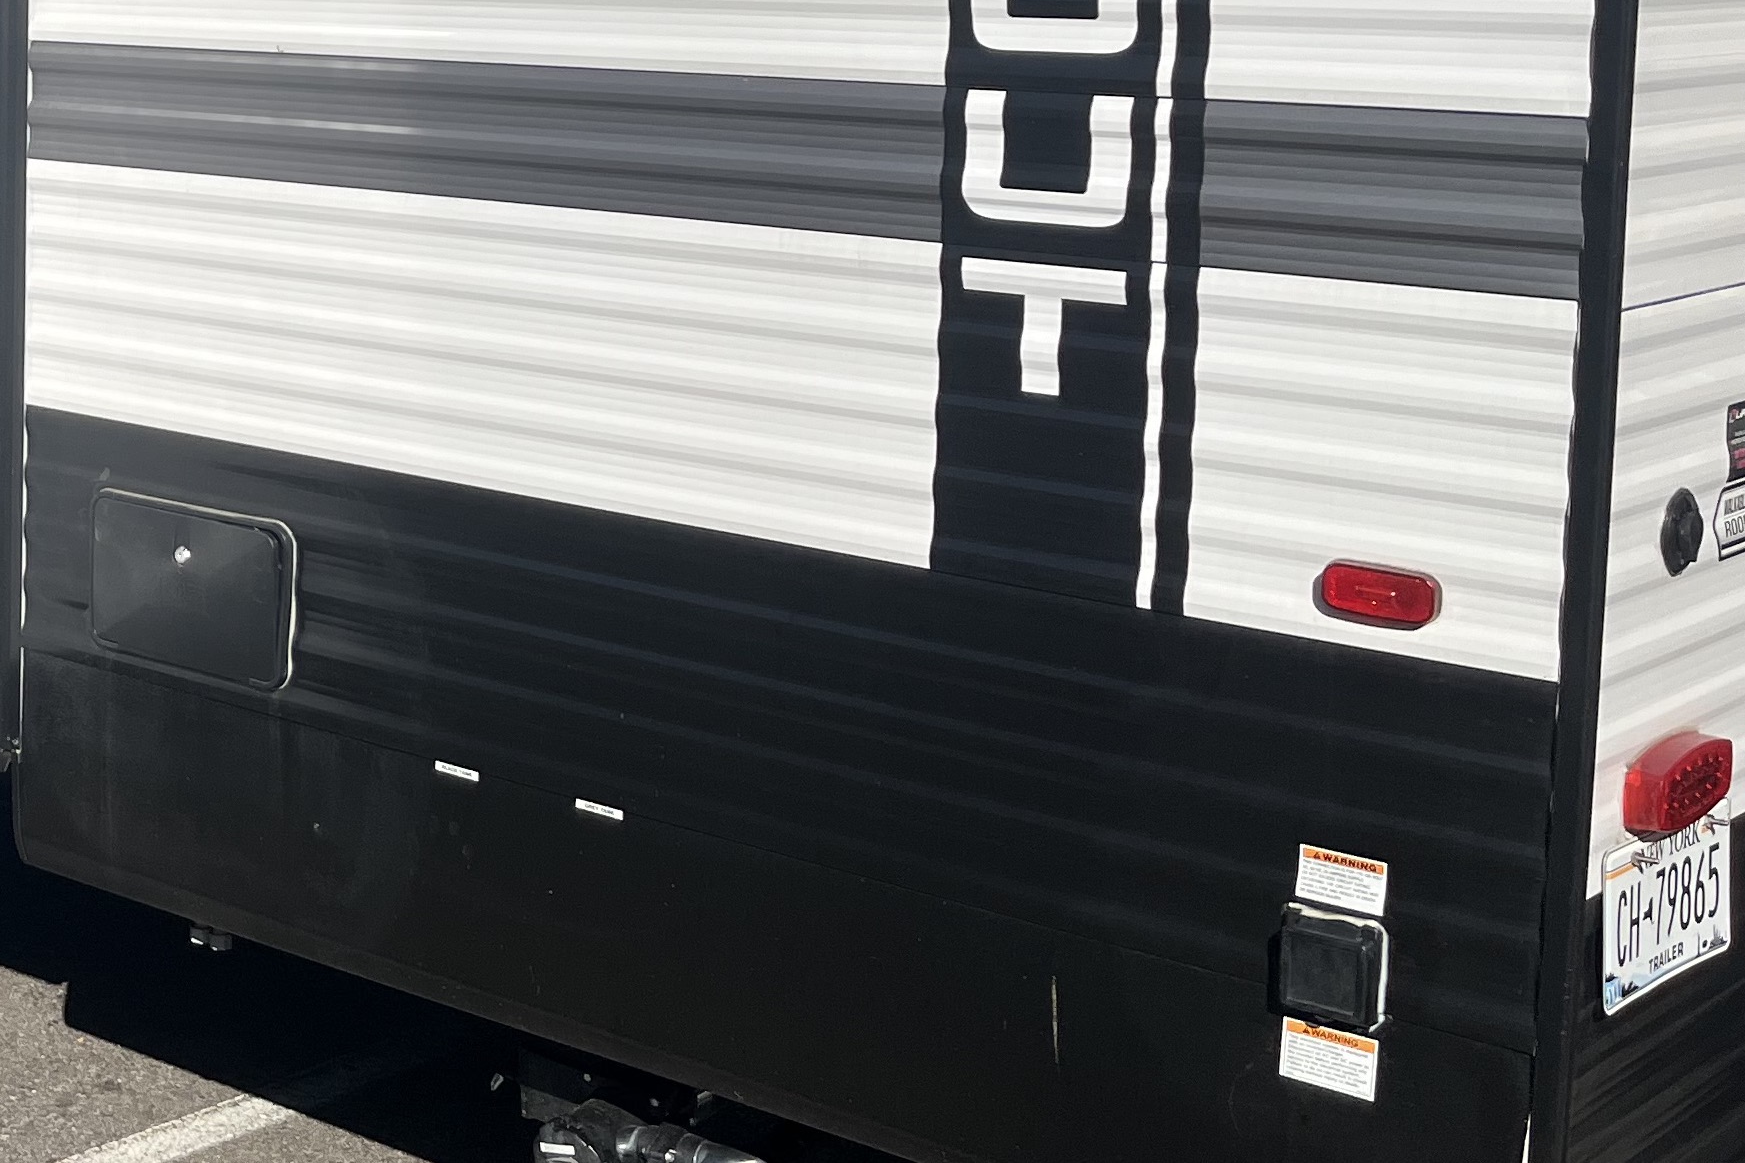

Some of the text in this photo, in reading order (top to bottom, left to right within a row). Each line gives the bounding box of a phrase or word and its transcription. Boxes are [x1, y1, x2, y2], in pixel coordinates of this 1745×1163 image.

[1724, 514, 1745, 538] ROO
[1668, 820, 1701, 856] YORK
[1322, 853, 1377, 873] WARNING
[1648, 941, 1684, 975] TRAILER
[1311, 1028, 1359, 1048] WARNING
